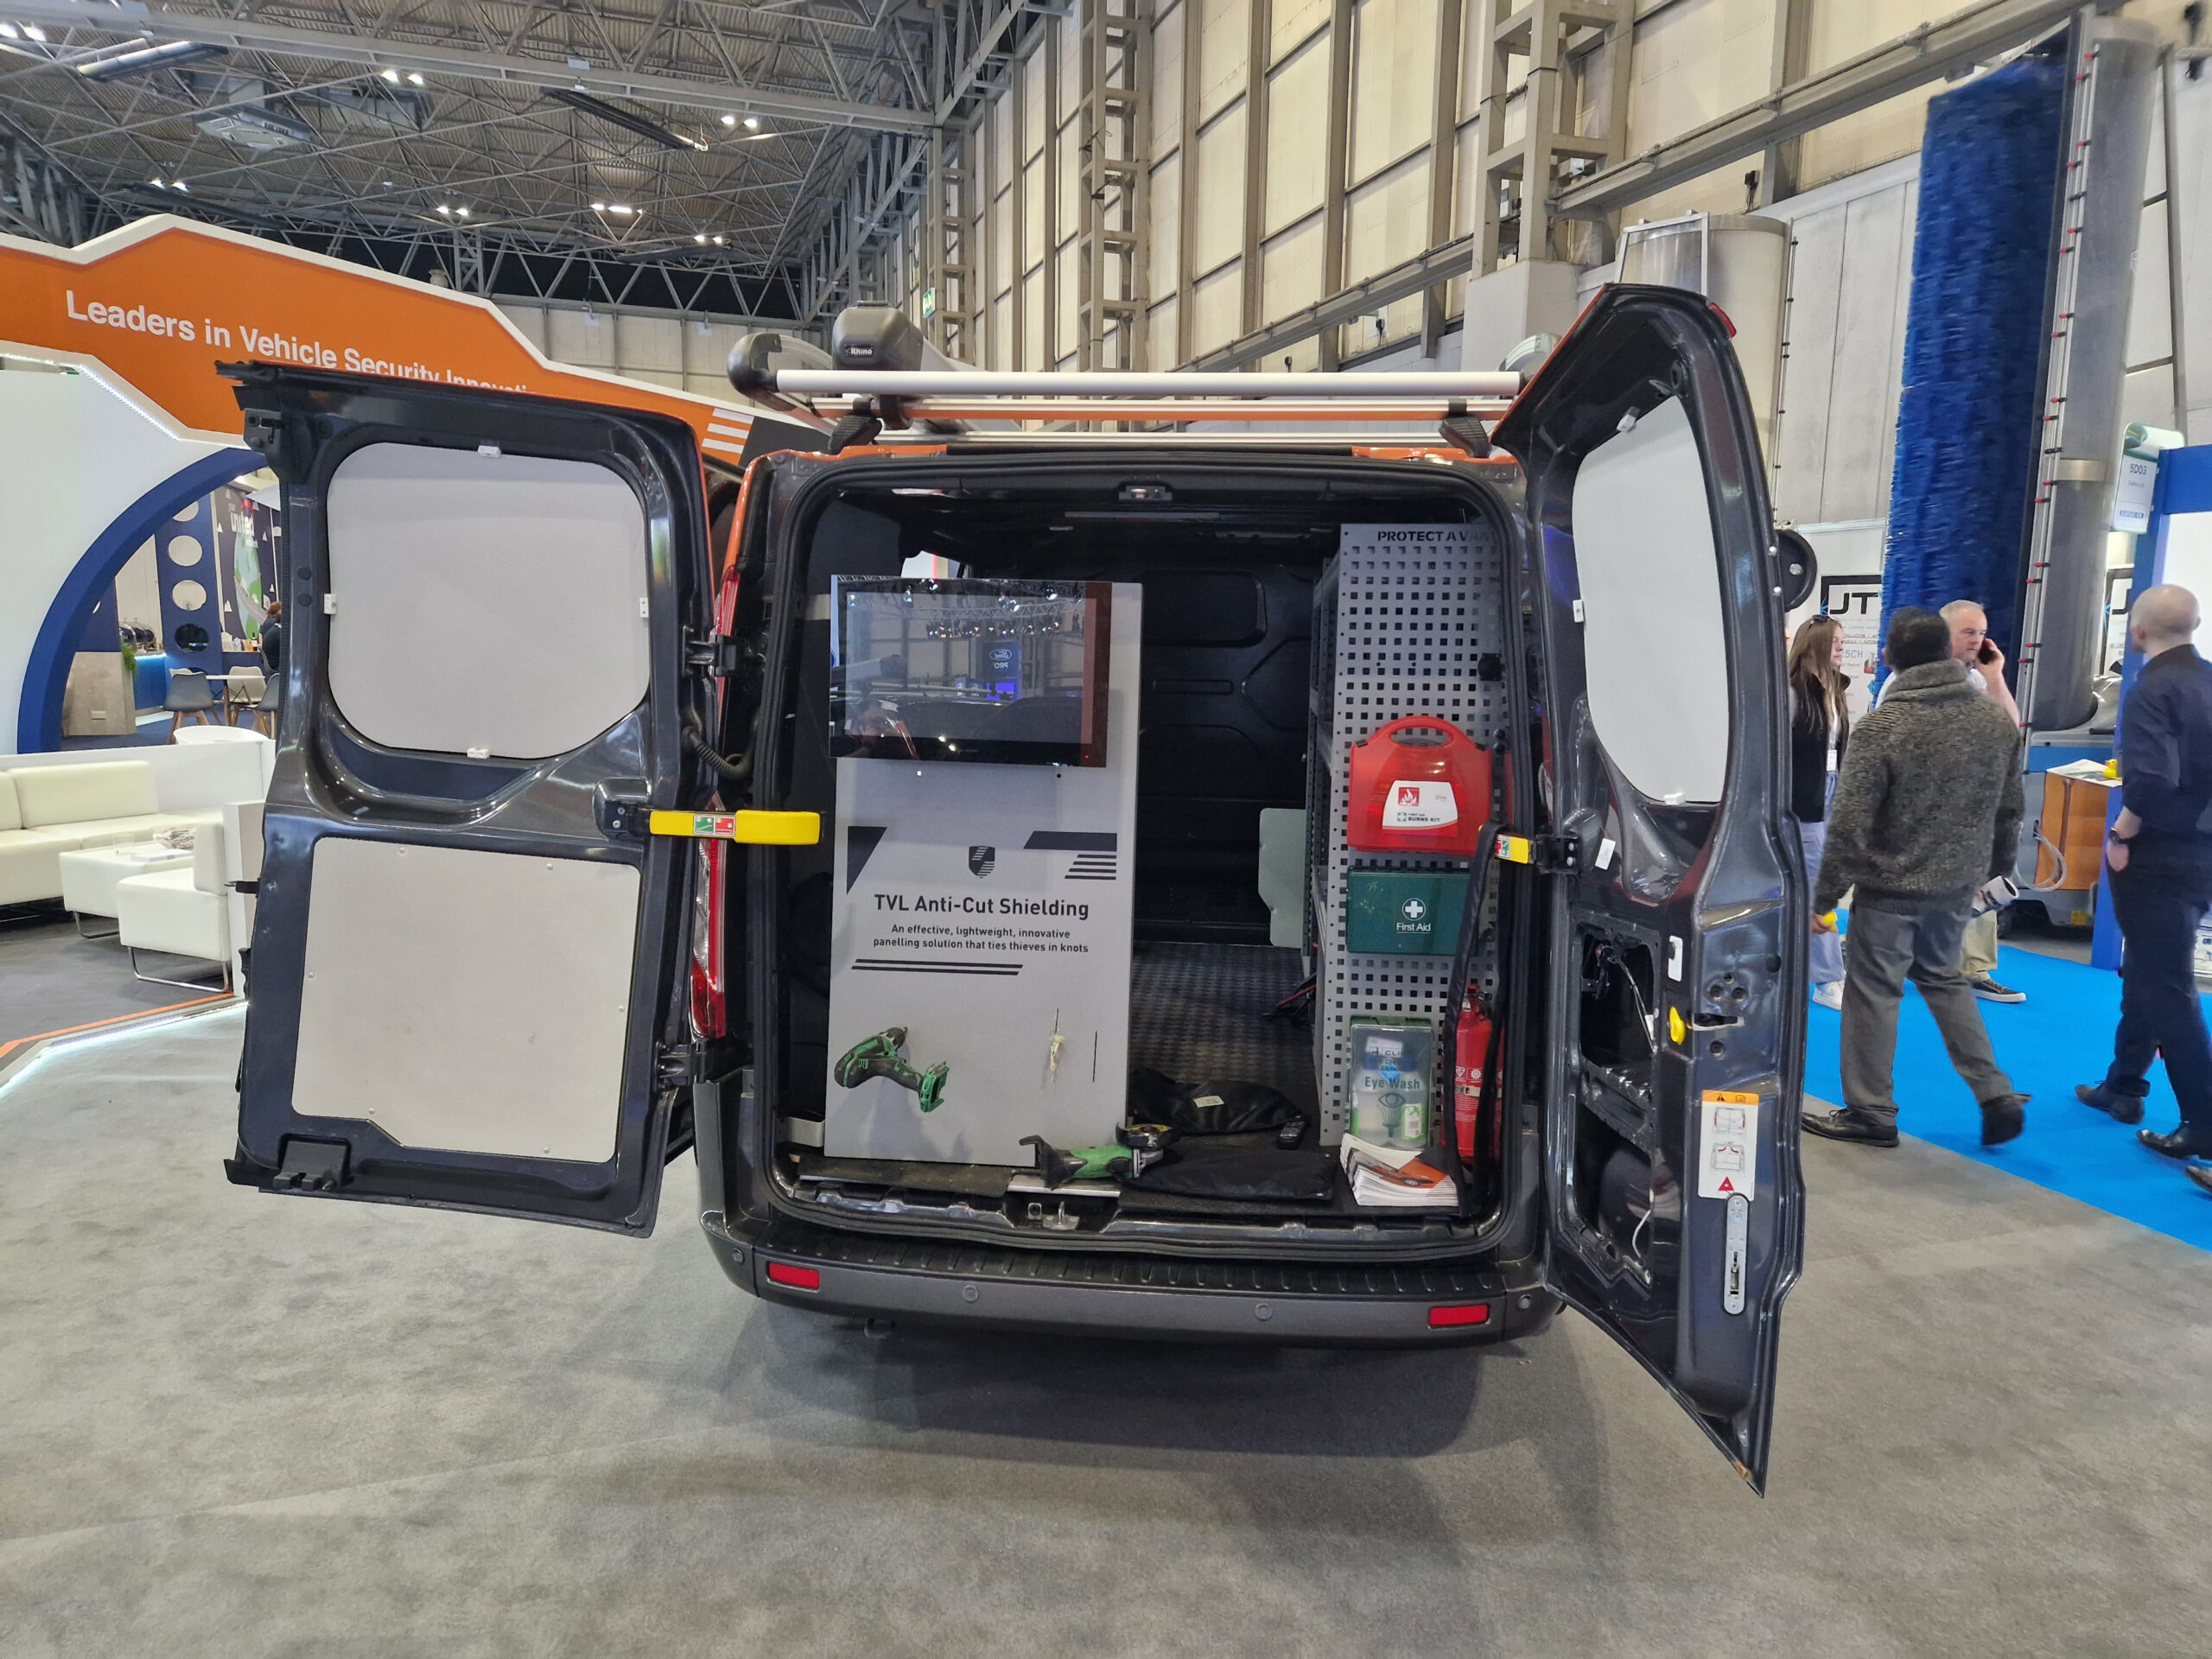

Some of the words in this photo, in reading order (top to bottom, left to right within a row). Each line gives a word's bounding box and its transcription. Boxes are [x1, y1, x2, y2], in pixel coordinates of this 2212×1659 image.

[66, 289, 196, 342] Leaders
[204, 318, 232, 348] in
[239, 325, 337, 369] Vehicle
[2129, 463, 2147, 475] 5D03
[1377, 531, 1444, 541] PROTECT
[874, 893, 909, 912] TVL
[914, 895, 994, 914] Anti-Cut
[999, 898, 1089, 920] Shielding
[891, 924, 905, 933] An
[907, 925, 953, 936] effective,
[956, 926, 1016, 938] lightweight,
[1018, 928, 1071, 939] innovative
[1396, 922, 1414, 931] First
[1416, 922, 1431, 931] Aid
[873, 938, 919, 949] panelling
[922, 938, 963, 949] solution
[965, 940, 985, 950] that
[988, 941, 1007, 950] ties
[1009, 941, 1046, 951] thieves
[1048, 942, 1058, 951] in
[1060, 943, 1089, 953] knots
[1365, 1077, 1384, 1090] Eye
[1389, 1077, 1420, 1090] Wash
